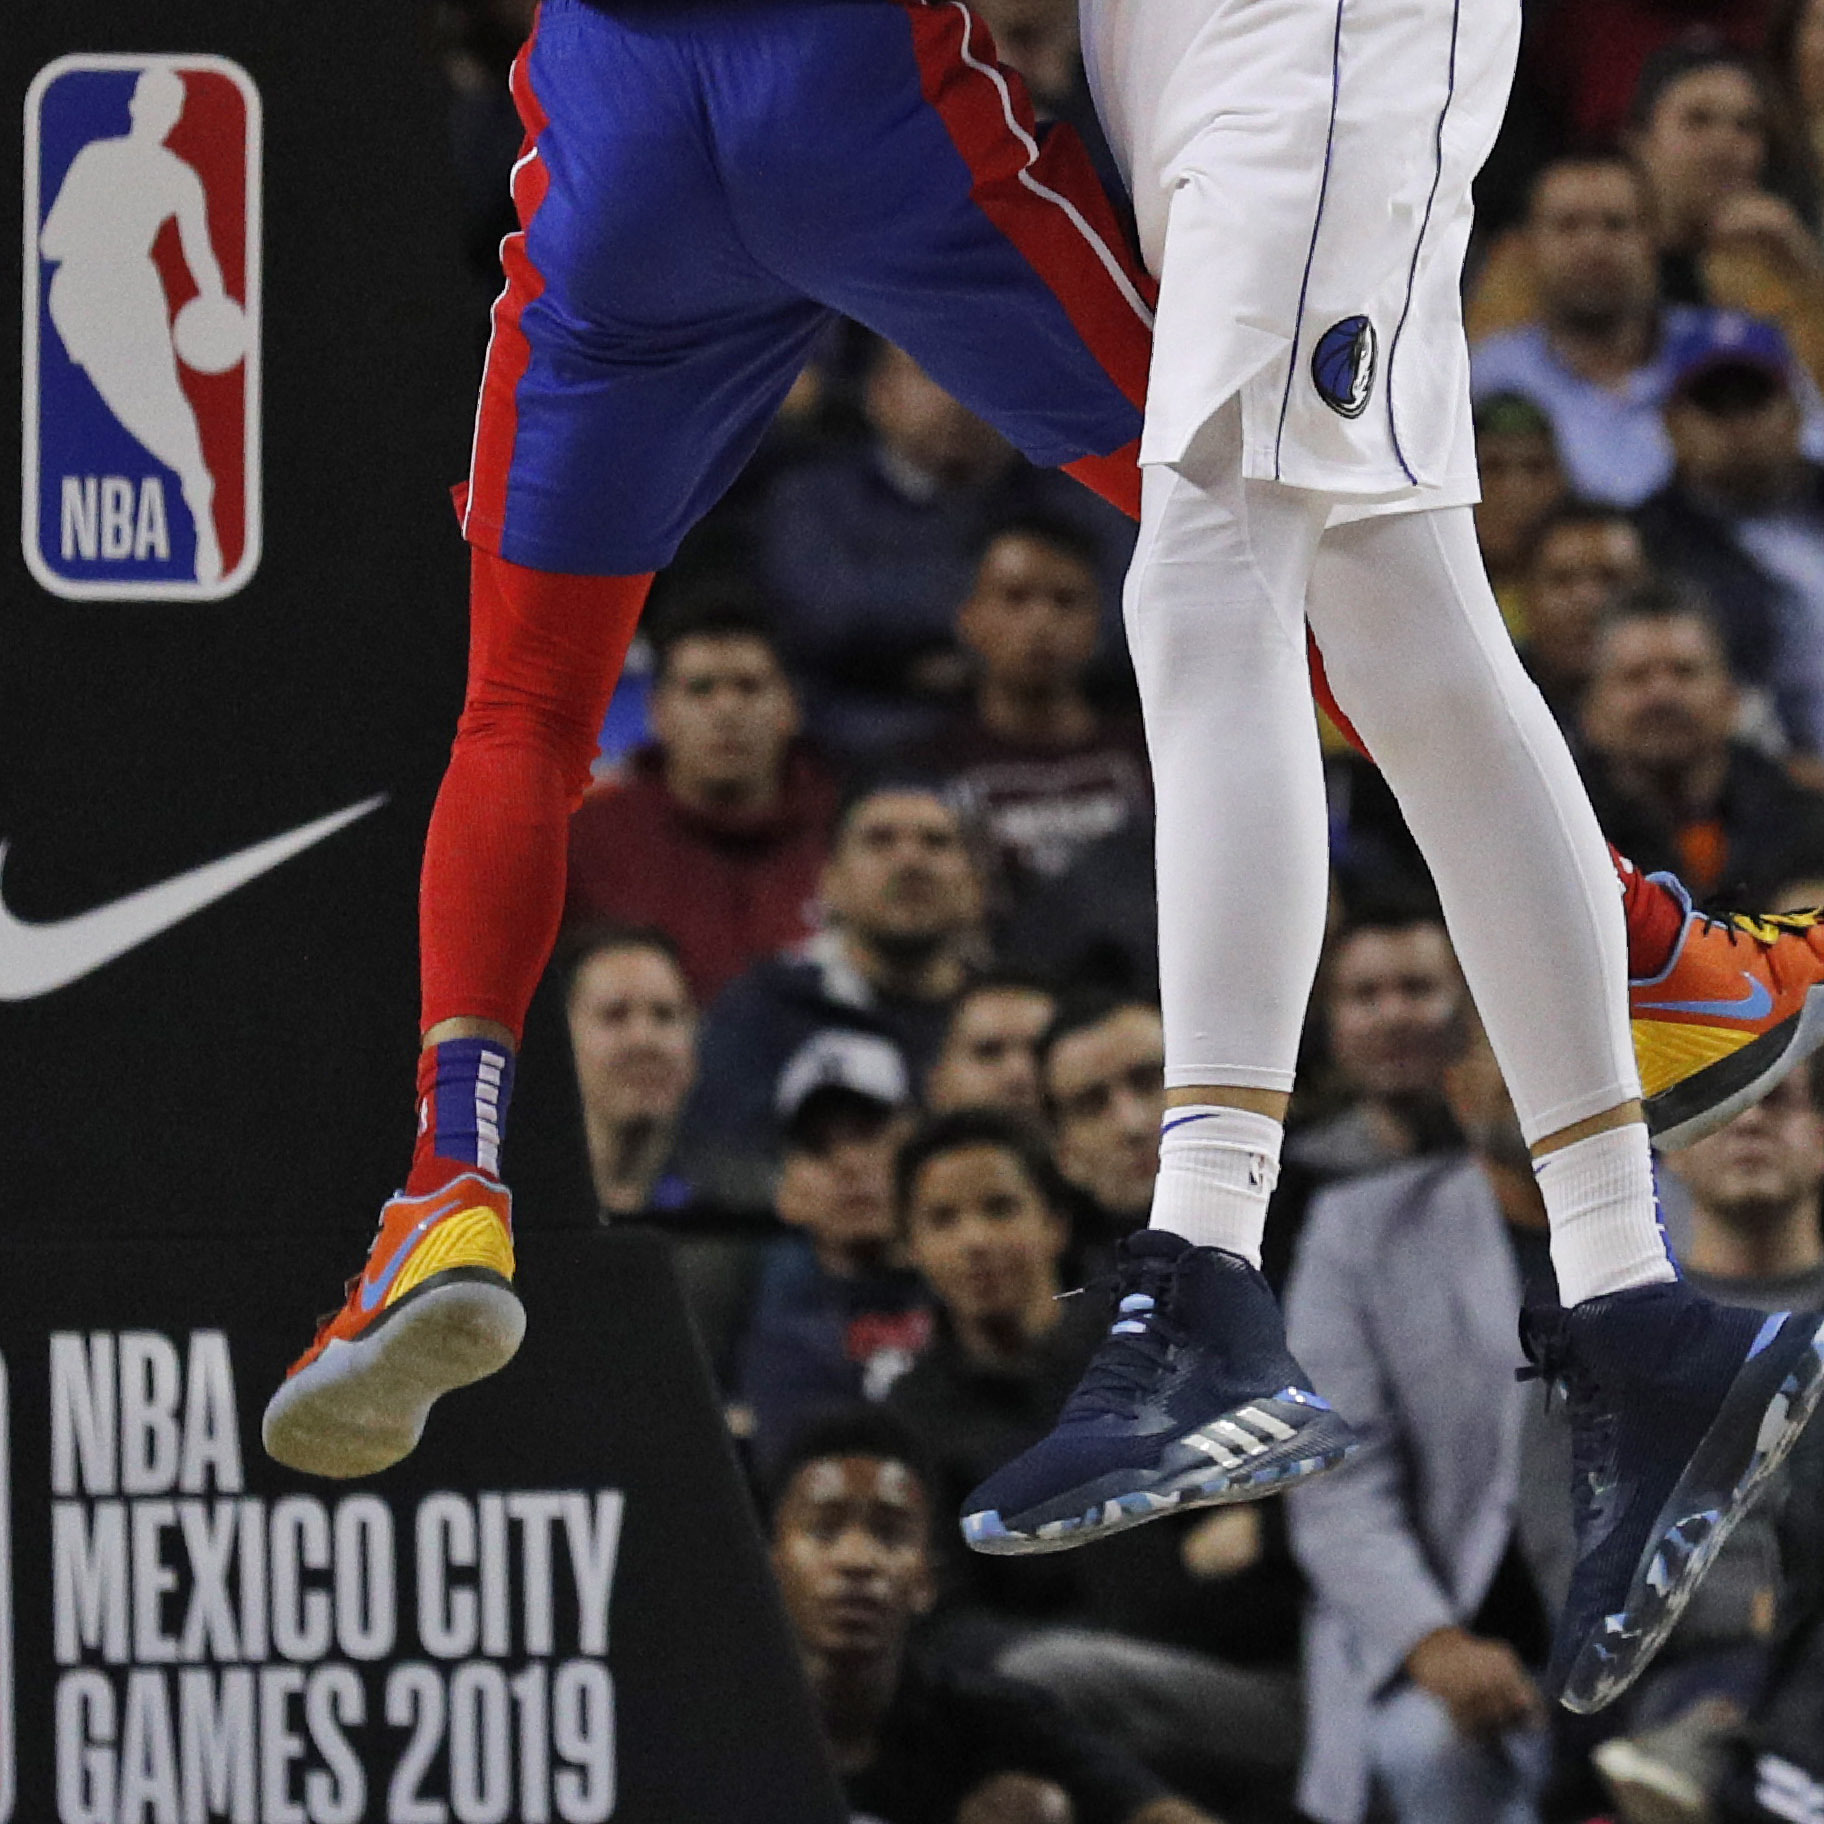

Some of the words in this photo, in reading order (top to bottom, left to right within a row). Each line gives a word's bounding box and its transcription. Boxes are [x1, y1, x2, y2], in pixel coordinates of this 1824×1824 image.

[60, 474, 171, 561] NBA
[49, 1328, 246, 1497] NBA
[51, 1491, 400, 1665] MEXICO
[415, 1487, 626, 1660] CITY
[54, 1663, 368, 1824] GAMES
[384, 1658, 618, 1824] 2019
